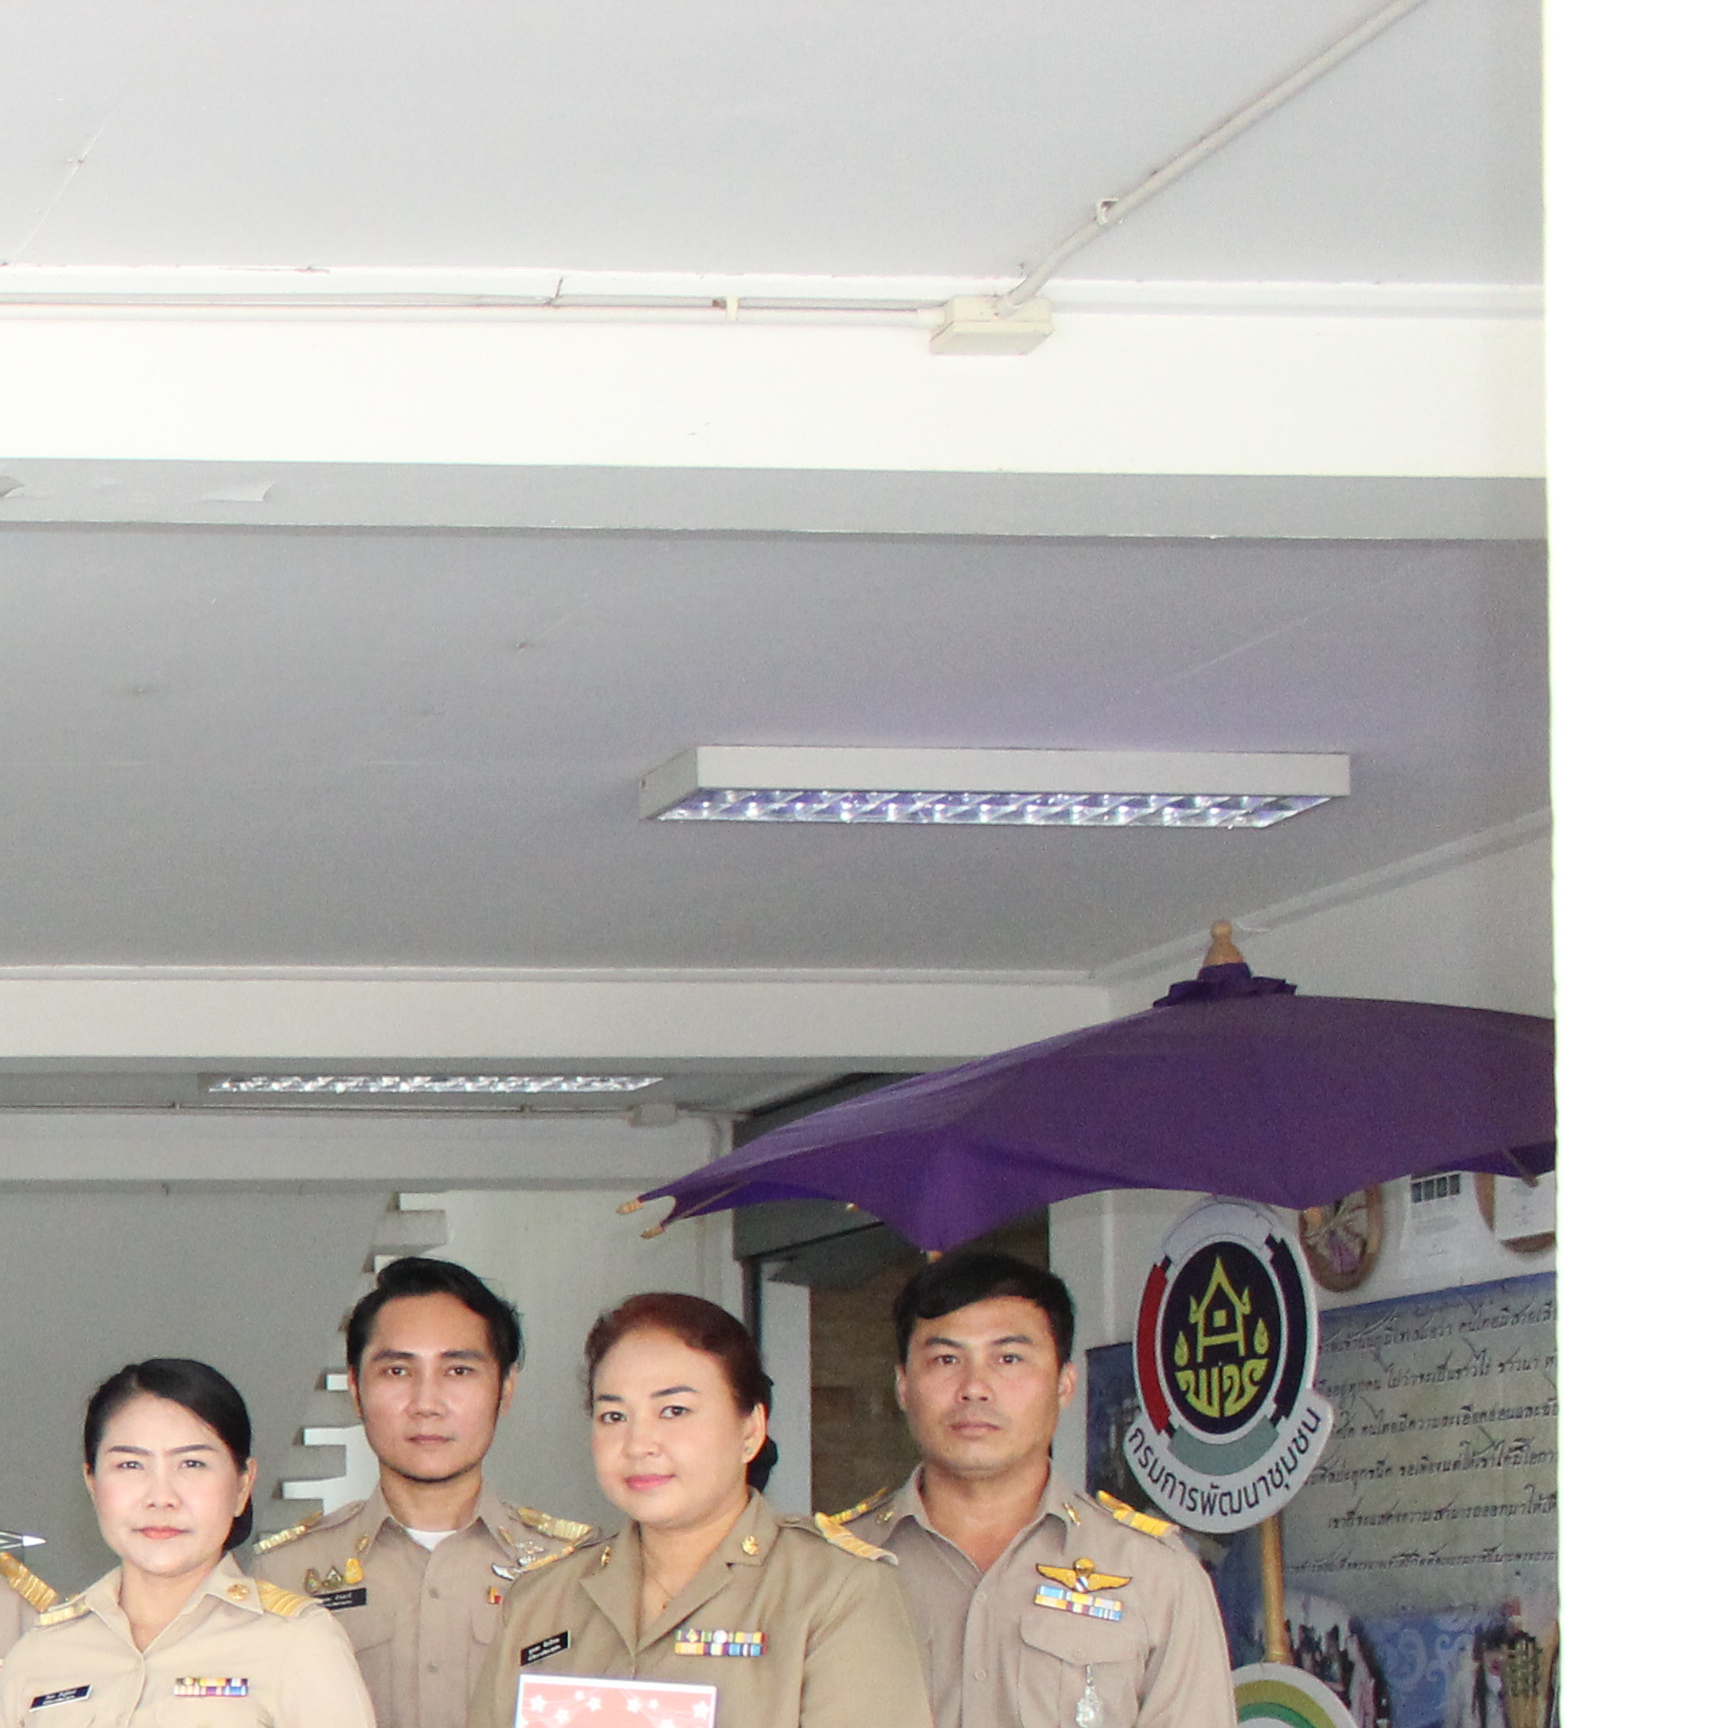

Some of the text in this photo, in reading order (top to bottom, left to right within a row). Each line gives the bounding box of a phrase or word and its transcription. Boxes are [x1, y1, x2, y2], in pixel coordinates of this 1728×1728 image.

[1127, 1406, 1322, 1518] กรมการพัฒนาชุมชน
